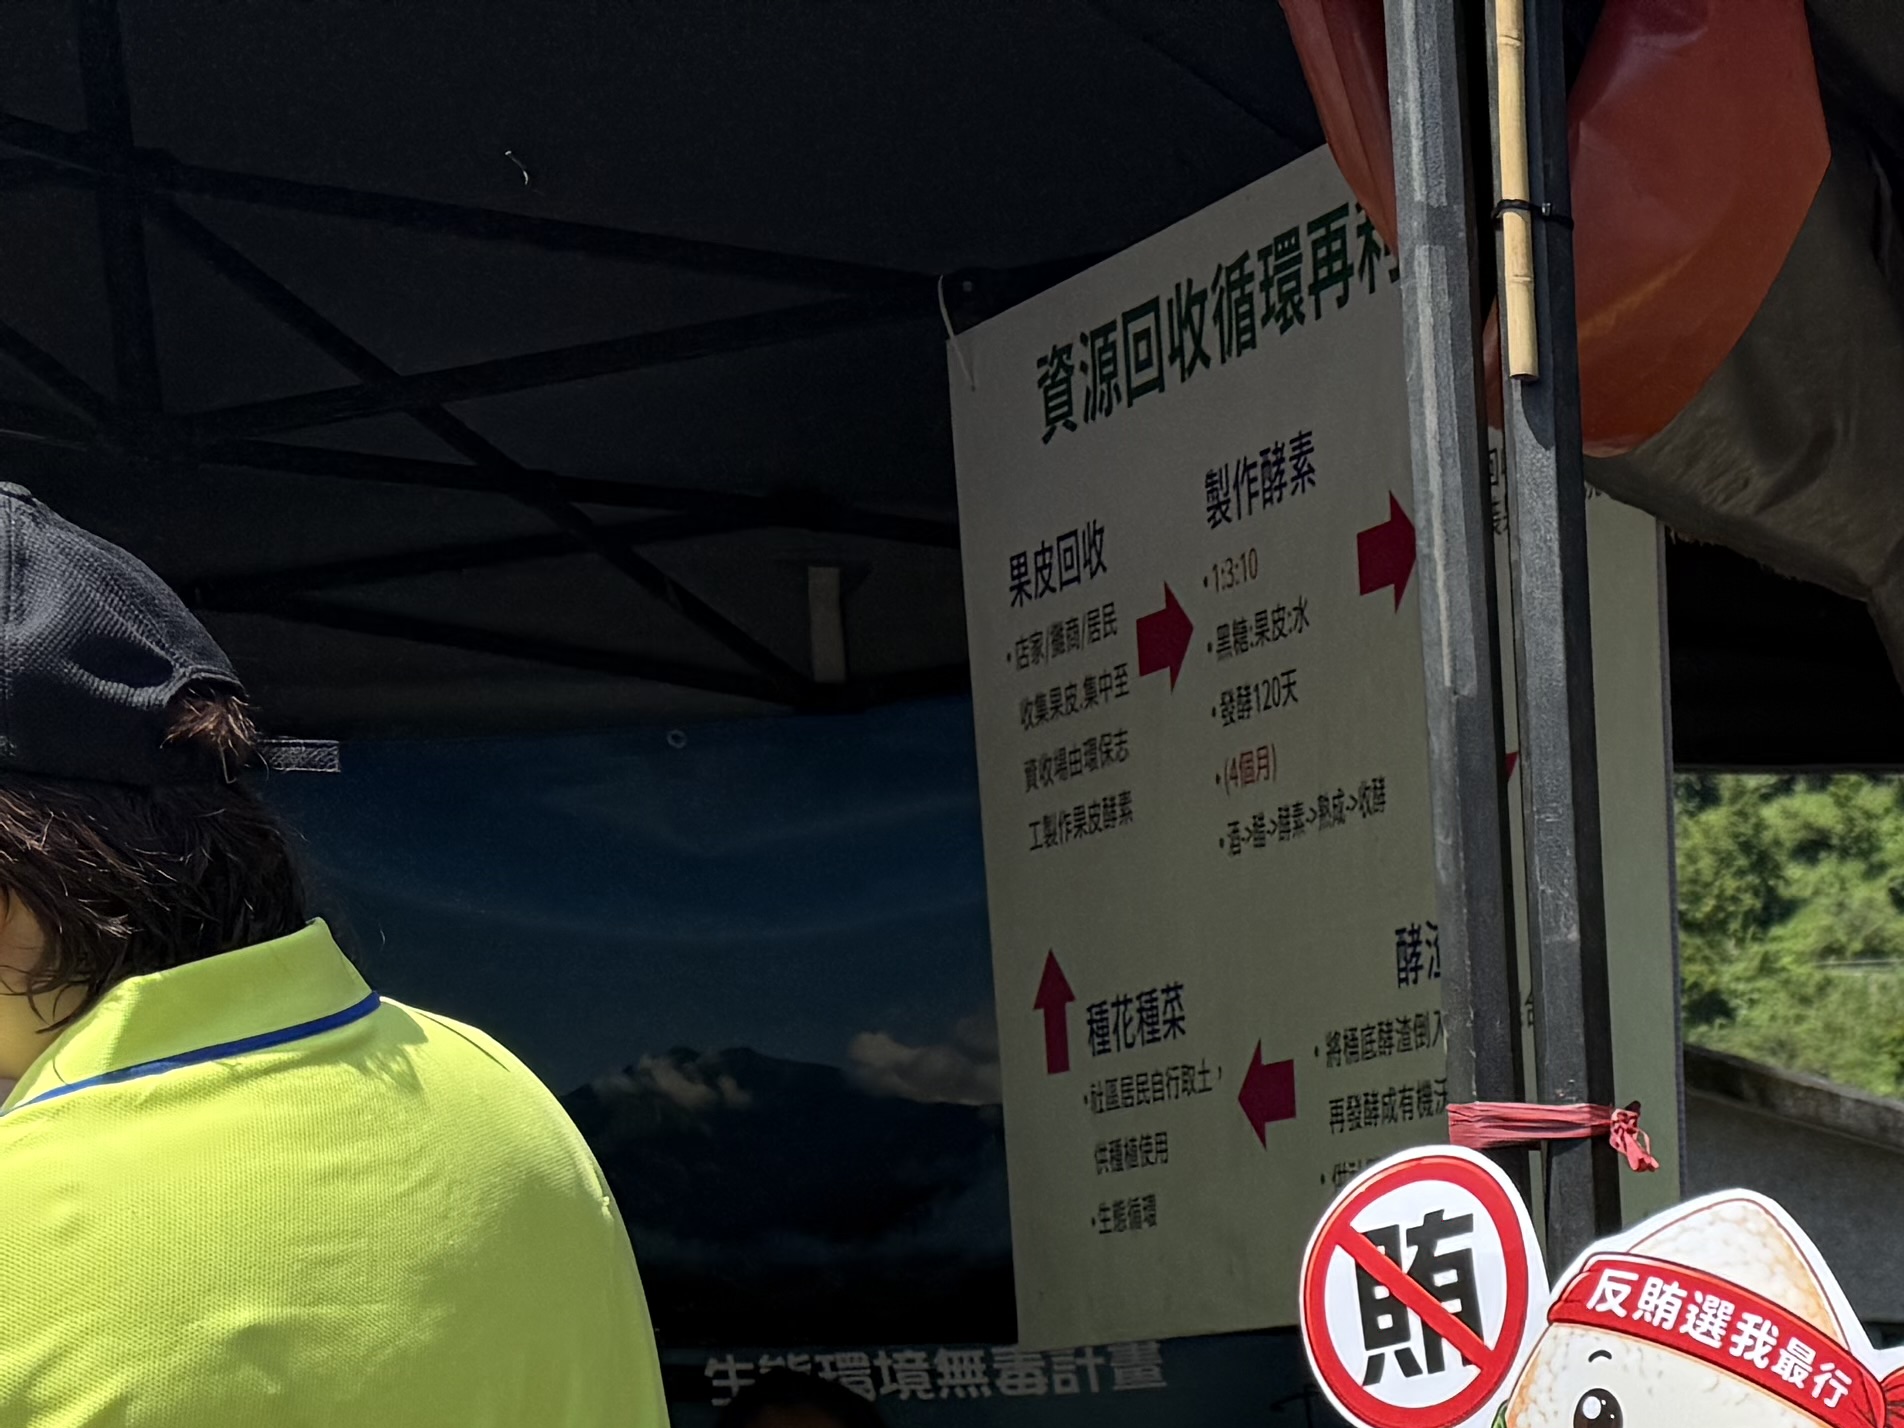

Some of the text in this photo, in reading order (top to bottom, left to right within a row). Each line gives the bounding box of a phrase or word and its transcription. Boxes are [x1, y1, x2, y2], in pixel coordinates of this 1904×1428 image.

[1204, 431, 1317, 530] 製作酵素
[1007, 520, 1109, 608] 果皮回收
[1211, 547, 1259, 593] 1:3:10
[1219, 668, 1299, 728] 發酵120天
[1223, 743, 1279, 797] (4個月)
[1087, 981, 1187, 1058] 種花種菜
[1586, 1267, 1854, 1411] 反賄選我最行
